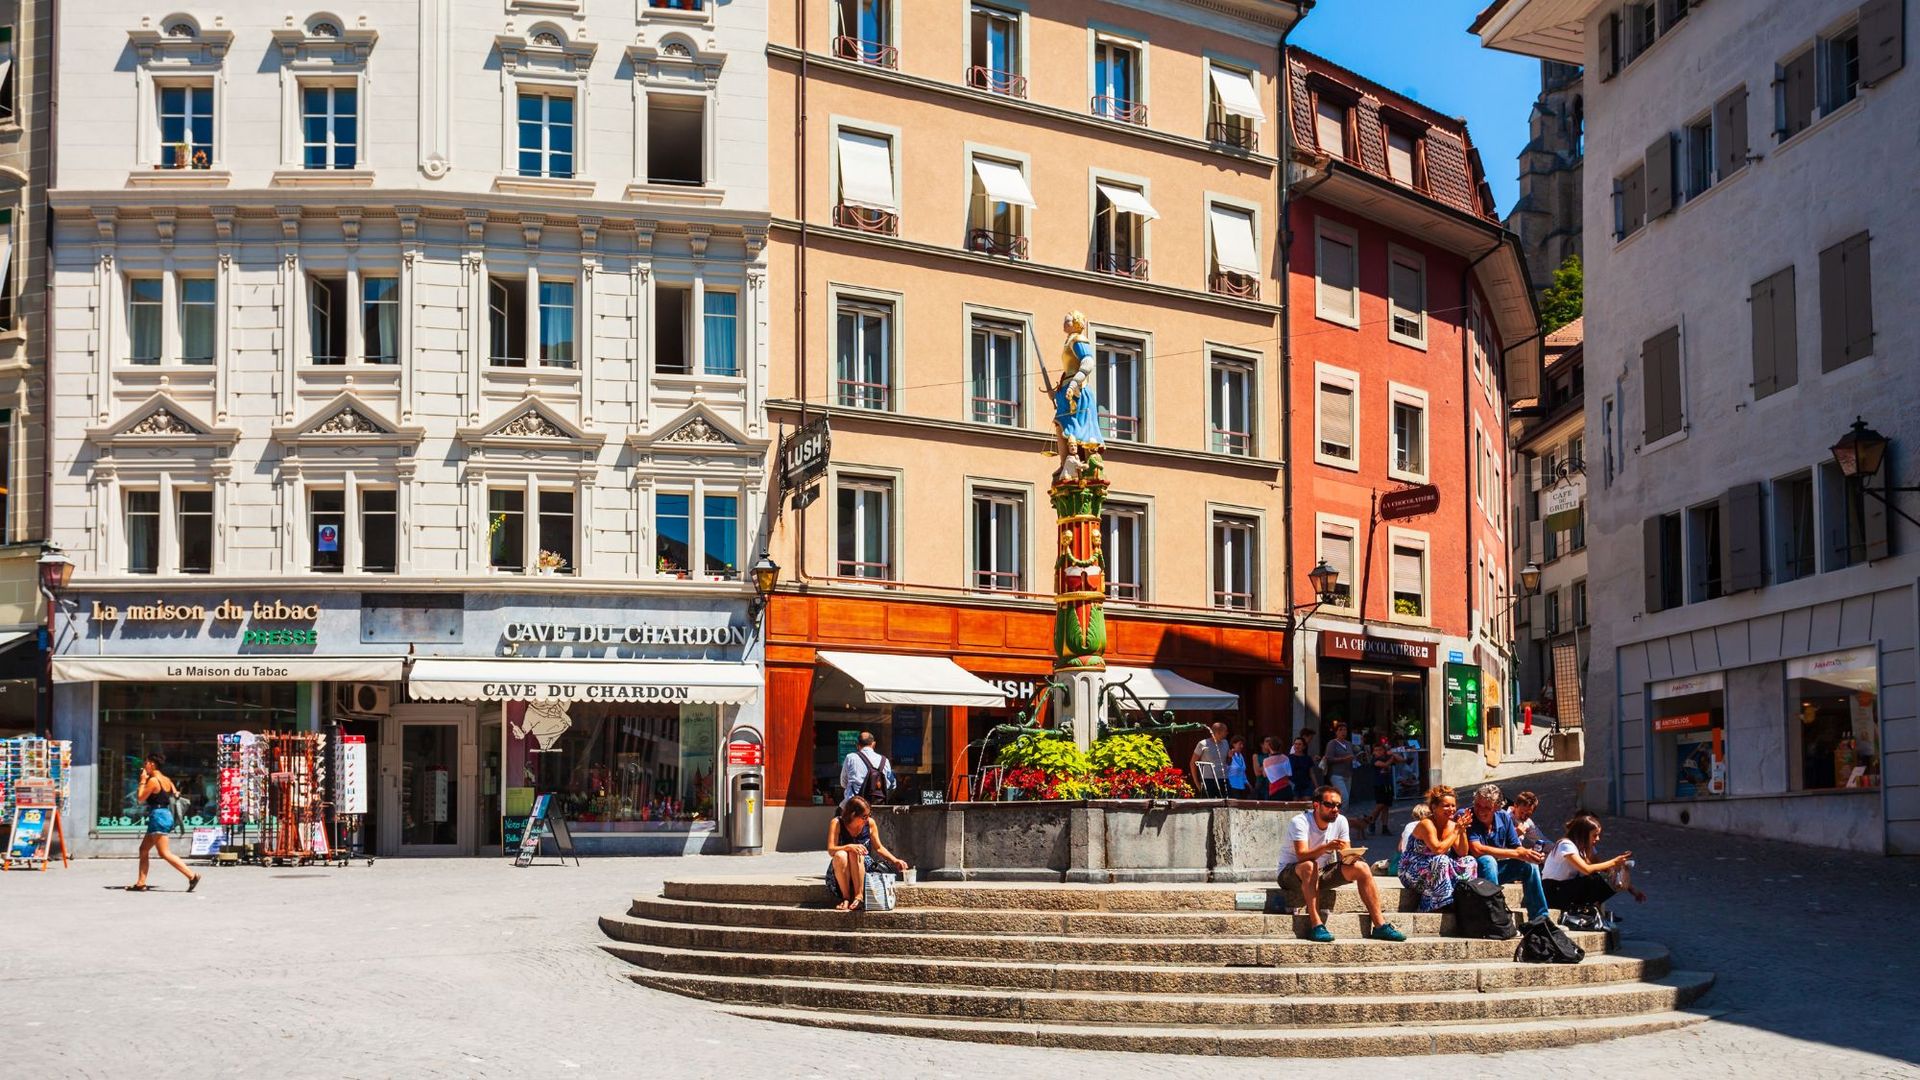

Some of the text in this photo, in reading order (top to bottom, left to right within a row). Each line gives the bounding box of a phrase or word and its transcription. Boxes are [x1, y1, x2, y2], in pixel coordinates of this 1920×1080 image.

[787, 434, 822, 471] LUSH
[91, 598, 319, 620] La maison du tabac
[243, 629, 318, 646] PRESSE
[503, 622, 747, 645] CAVE DU CHARDON
[1335, 636, 1348, 650] LA
[1350, 638, 1422, 658] CHOCOLATIÈRE
[167, 666, 288, 677] La Maison du Tabac
[482, 684, 689, 699] CAVE DU CHARDON
